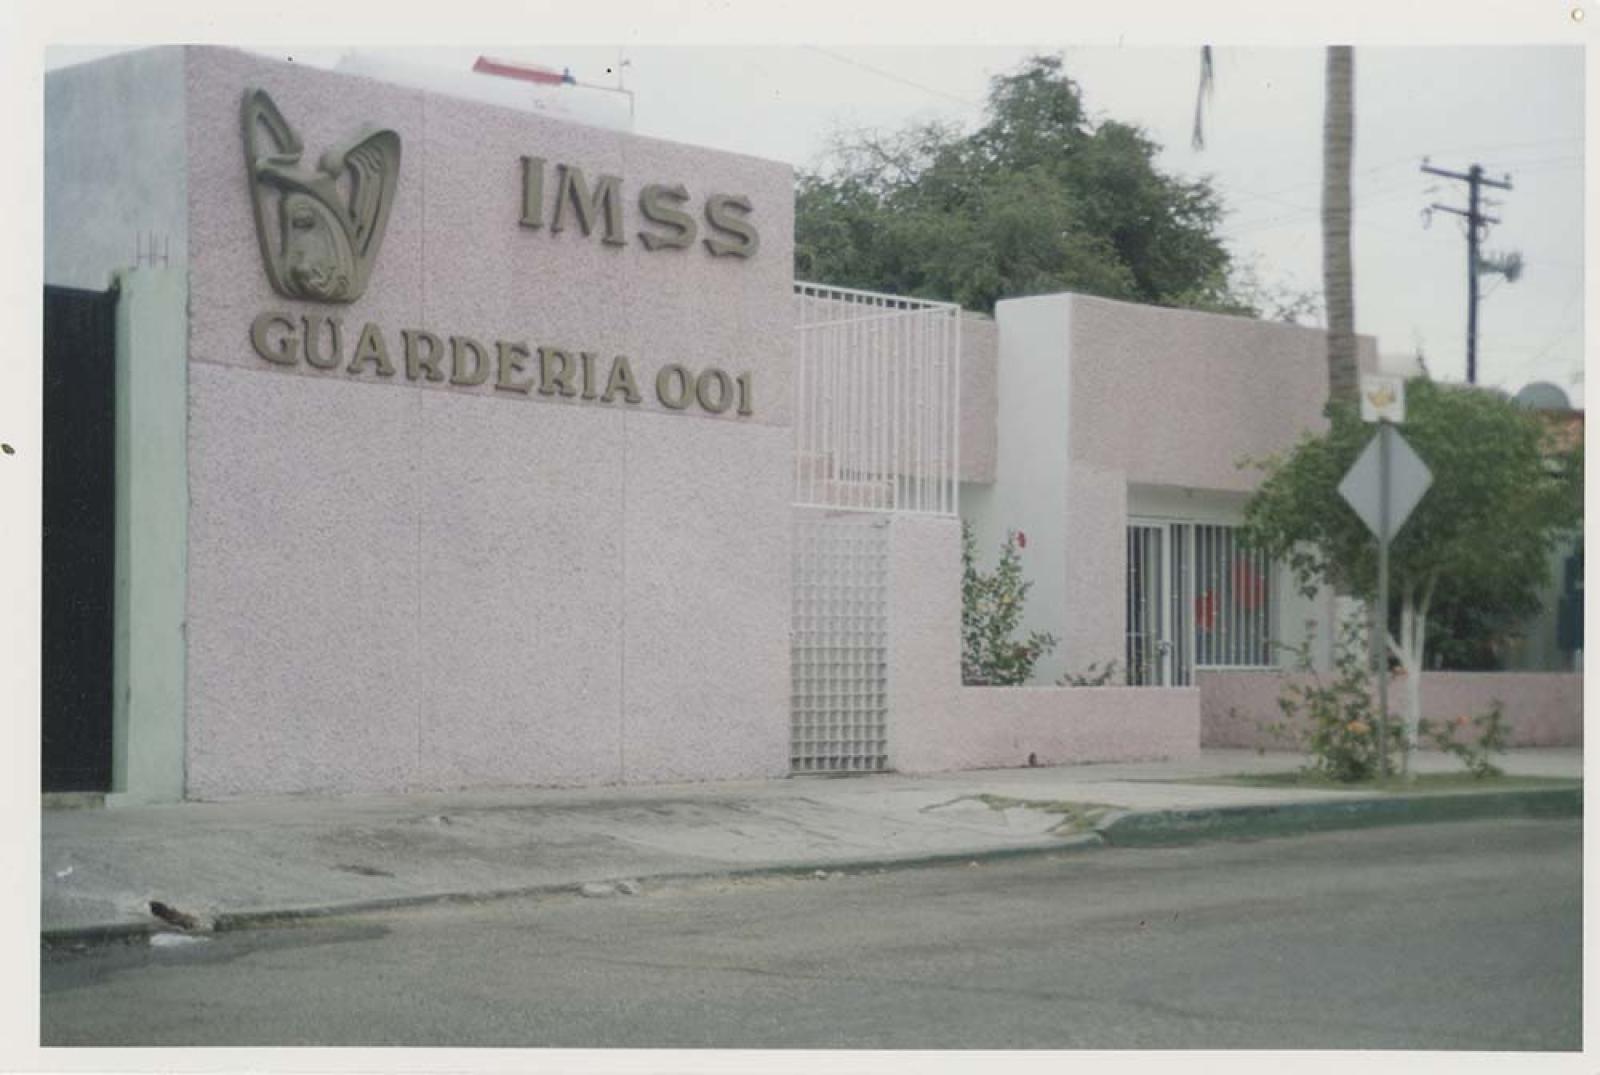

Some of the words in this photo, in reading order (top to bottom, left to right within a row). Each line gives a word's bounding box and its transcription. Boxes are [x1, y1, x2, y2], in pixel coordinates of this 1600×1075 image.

[518, 155, 761, 260] IMSS
[249, 311, 643, 407] GUARDERIA
[655, 362, 755, 418] 001
